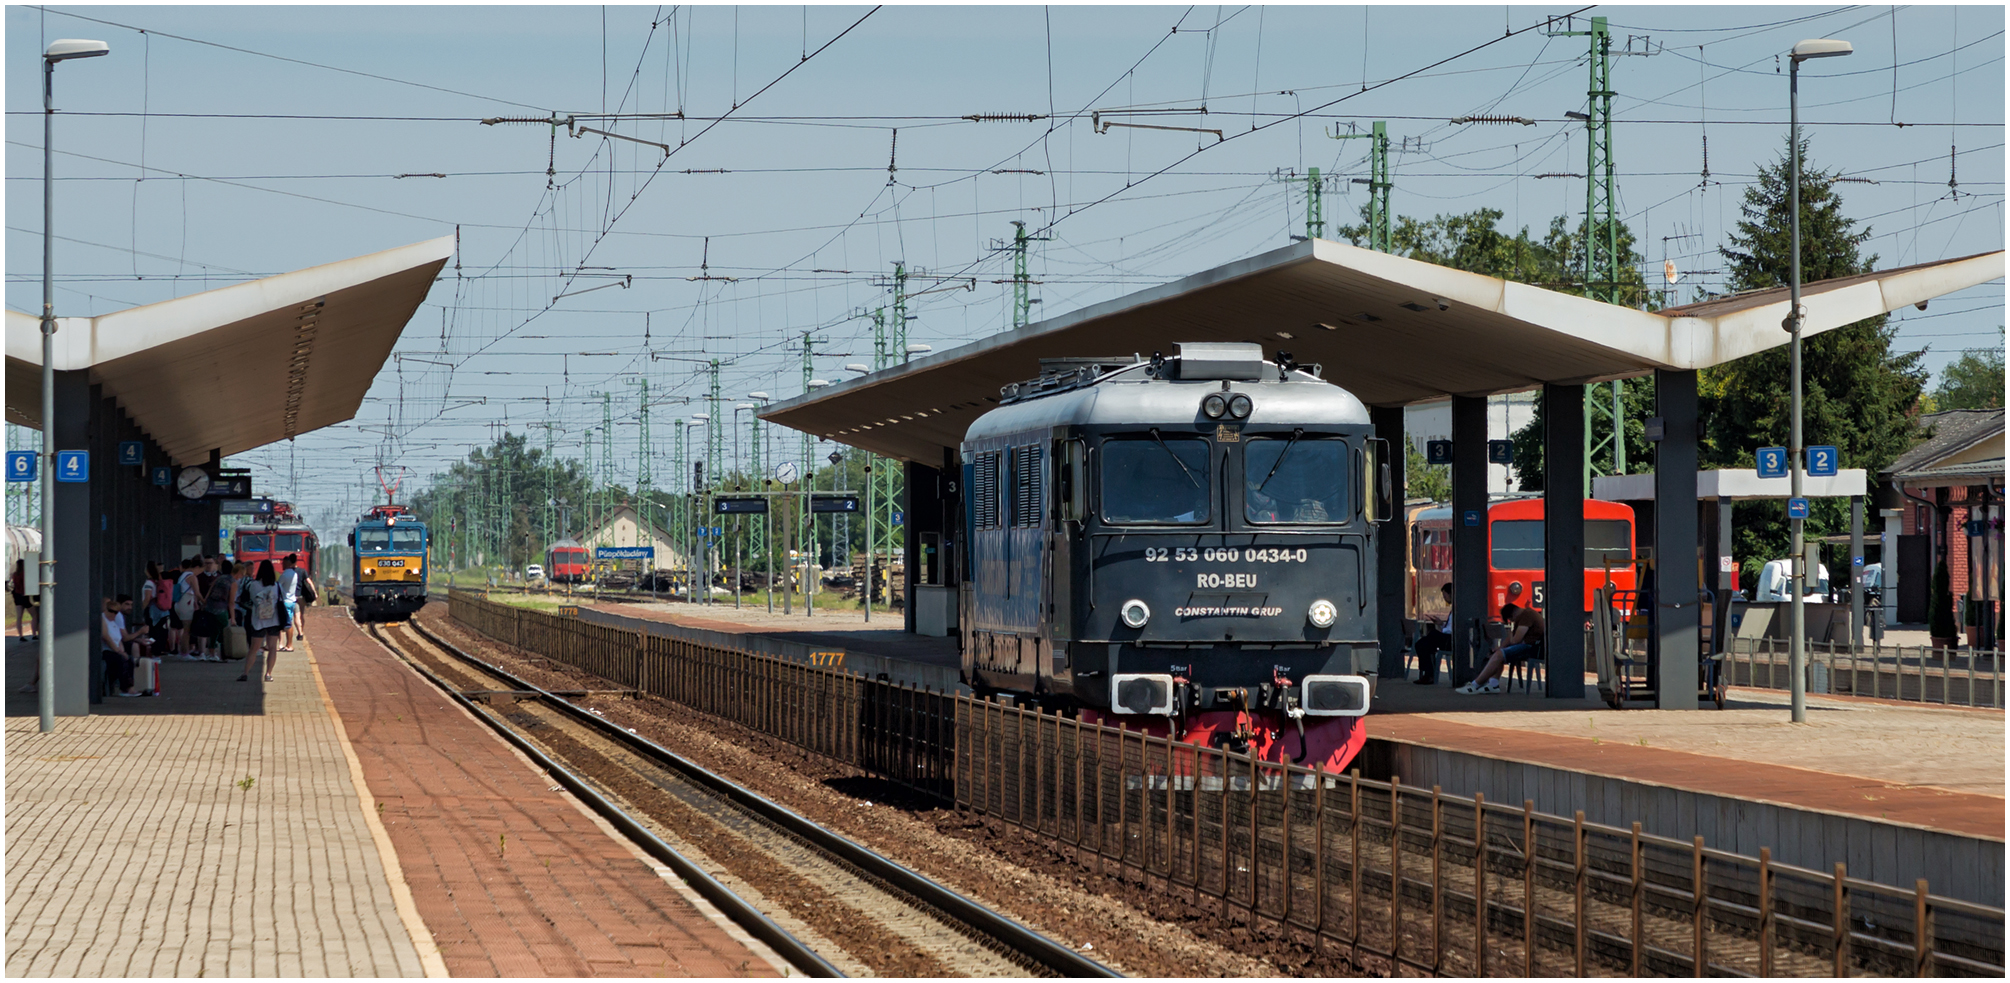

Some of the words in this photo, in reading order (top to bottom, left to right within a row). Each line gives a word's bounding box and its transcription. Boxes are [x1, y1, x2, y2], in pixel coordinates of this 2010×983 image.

[126, 444, 136, 457] 4
[1436, 444, 1444, 457] 3
[1496, 444, 1505, 457] 2
[15, 456, 28, 472] 6
[66, 456, 79, 472] 4
[1766, 452, 1778, 469] 3
[1816, 451, 1828, 467] 2
[157, 470, 166, 480] 4
[233, 482, 242, 493] 4
[948, 481, 957, 493] 3
[261, 503, 268, 512] 4
[721, 502, 728, 511] 3
[846, 500, 853, 509] 2
[895, 513, 901, 521] 3
[1972, 524, 1979, 534] 1
[1145, 547, 1169, 562] 92
[1175, 547, 1199, 562] 53
[1203, 547, 1239, 562] 060
[1245, 548, 1308, 563] 0434-0
[1197, 573, 1257, 588] RO-BEU
[1534, 587, 1543, 603] 5
[559, 607, 578, 616] 1778
[1175, 607, 1249, 617] CONSTANTIN
[1250, 607, 1283, 617] GRUP
[809, 651, 845, 666] 1777
